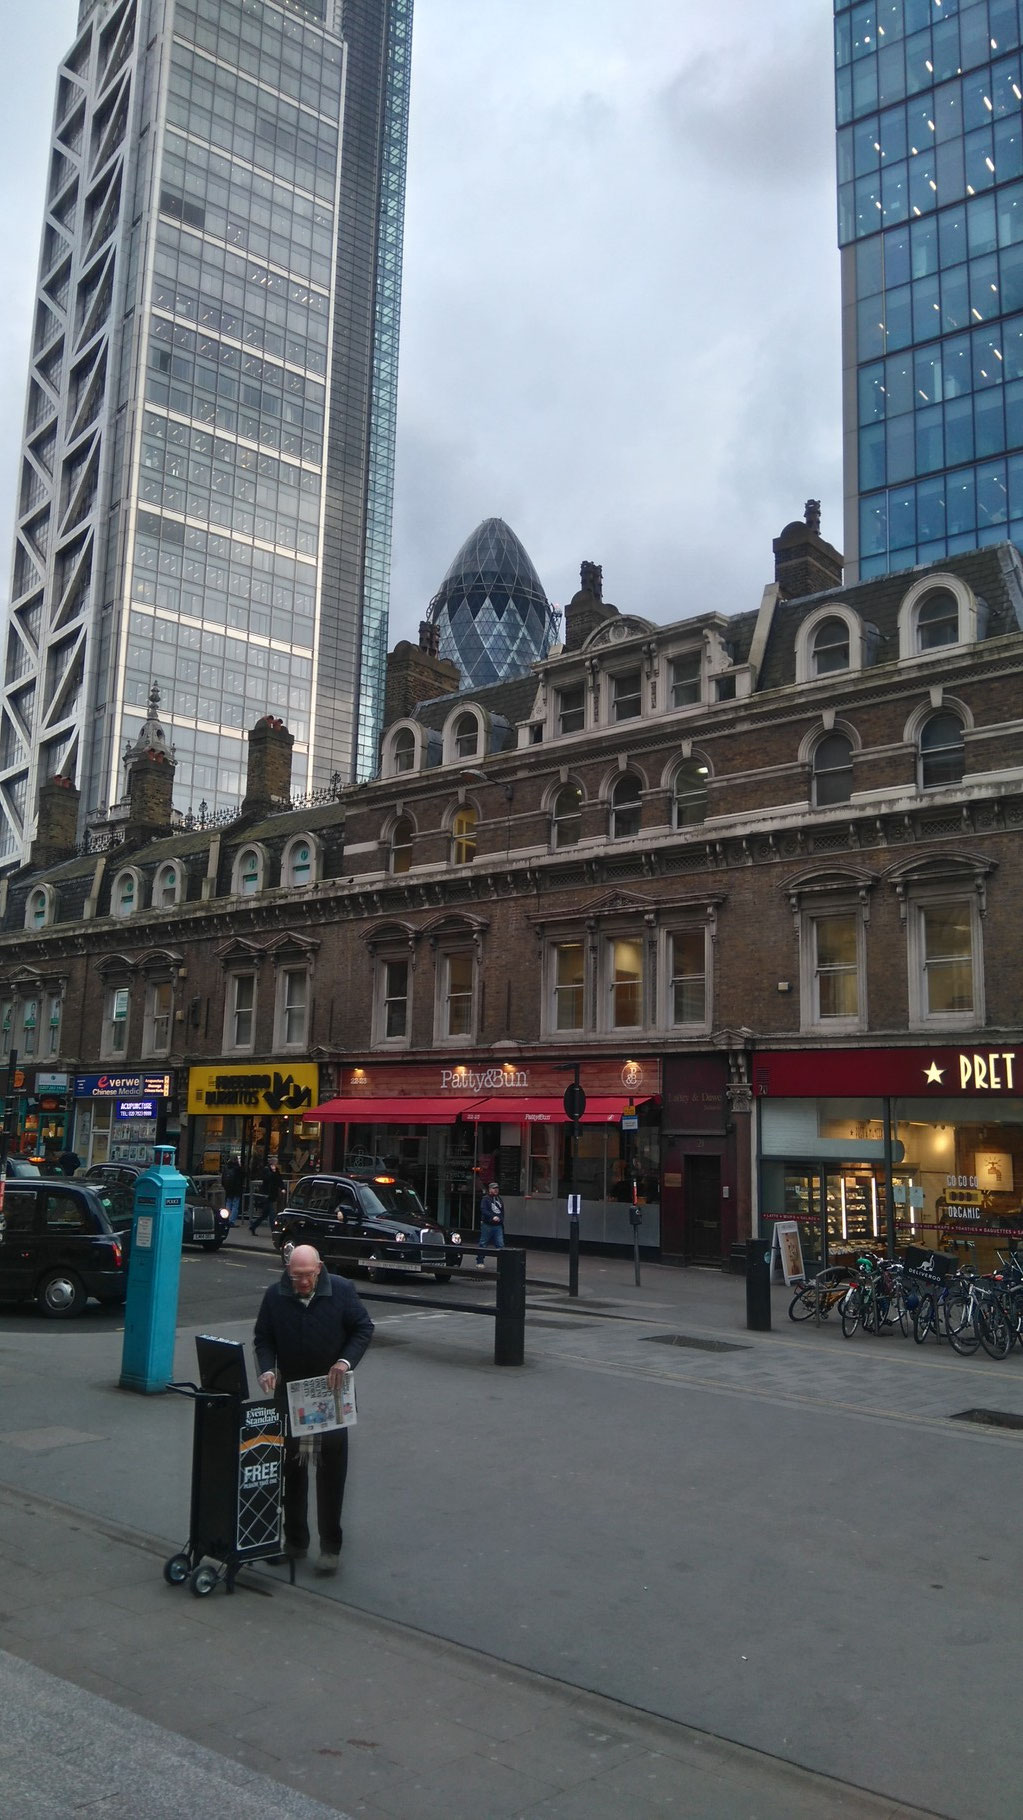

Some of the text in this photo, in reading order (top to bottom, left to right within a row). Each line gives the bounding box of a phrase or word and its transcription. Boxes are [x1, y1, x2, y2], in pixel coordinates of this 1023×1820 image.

[959, 1053, 1015, 1089] PRET
[440, 1068, 528, 1092] Patty&Bun
[92, 1088, 117, 1096] Chinese
[120, 1102, 152, 1110] ACUPUNCTURE
[946, 1175, 979, 1188] GO GO GO
[948, 1206, 980, 1219] ORGANIC
[245, 1413, 280, 1426] Standard
[246, 1407, 276, 1419] Evening
[244, 1462, 278, 1483] FREE
